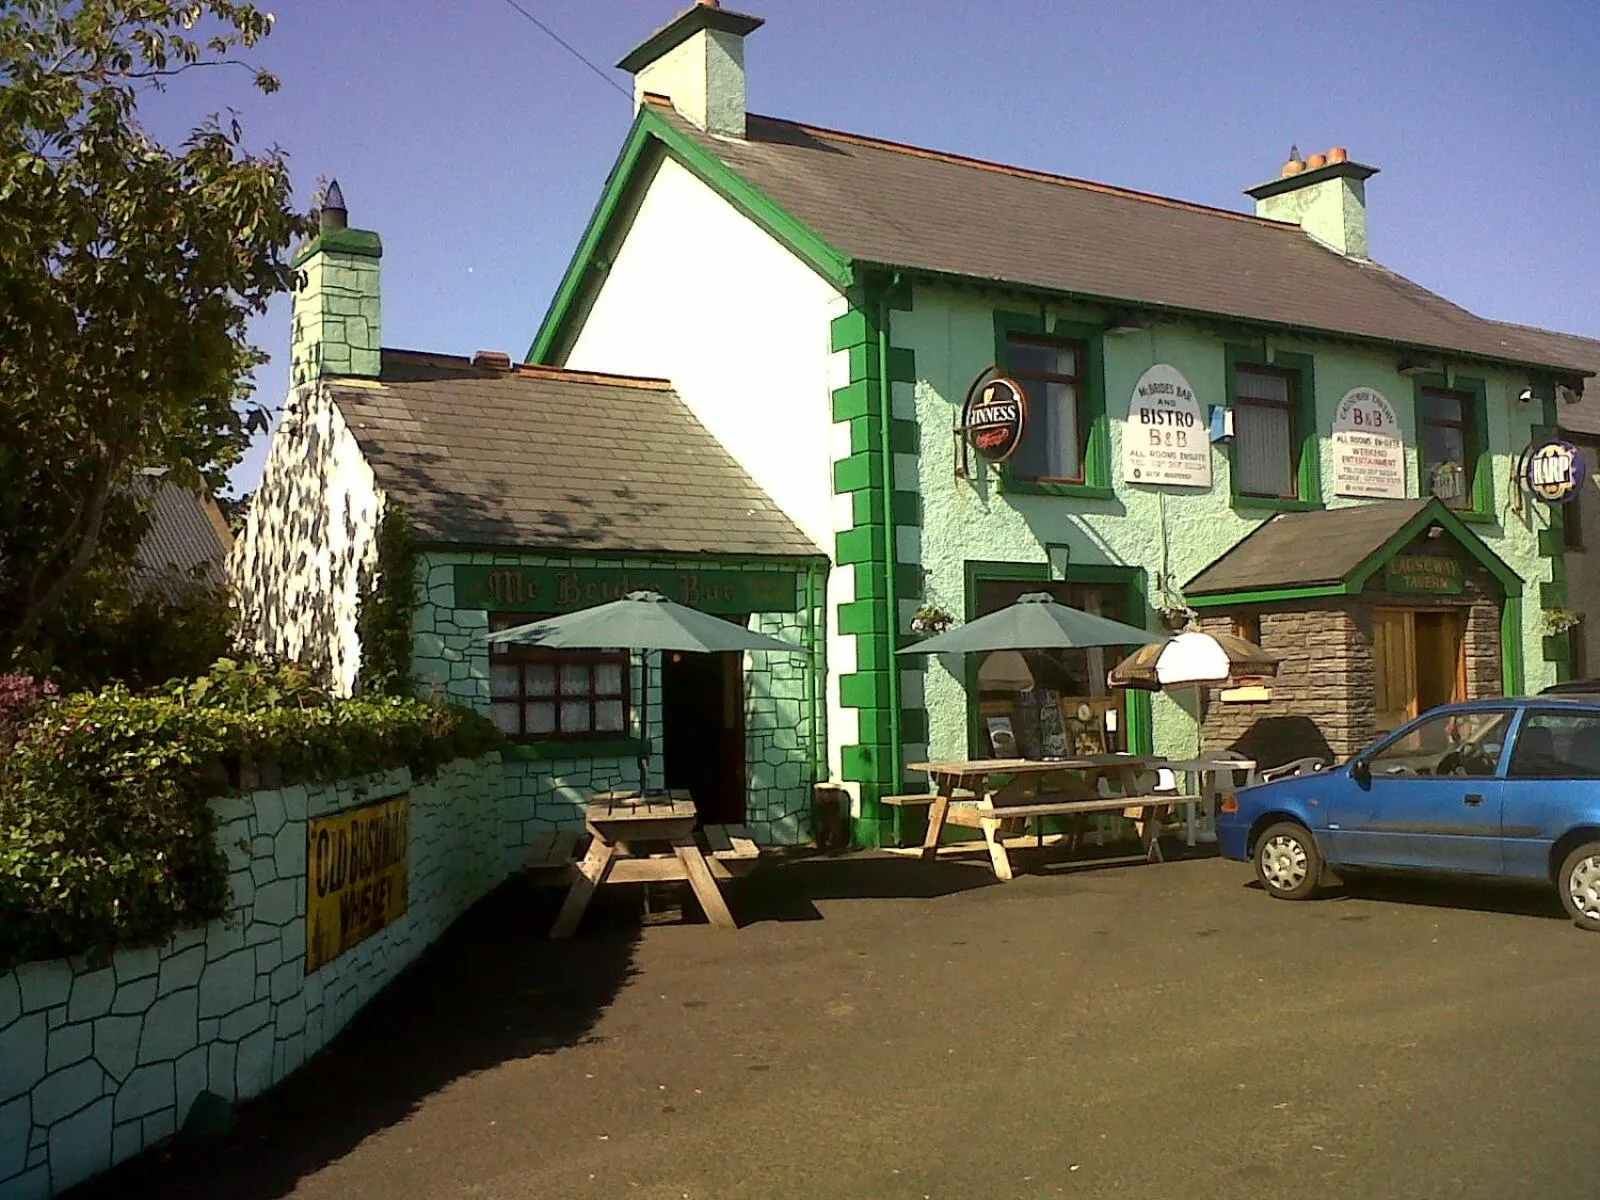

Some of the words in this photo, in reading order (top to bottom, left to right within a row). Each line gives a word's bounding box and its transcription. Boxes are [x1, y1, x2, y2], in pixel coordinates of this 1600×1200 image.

[1157, 398, 1176, 407] AND
[1176, 386, 1192, 401] BAR
[1140, 408, 1194, 428] BISTRO
[1150, 451, 1176, 460] ROOMS
[1533, 456, 1569, 485] HARP
[1391, 557, 1457, 576] CAUSEWAY
[680, 574, 734, 606] Bar
[1403, 575, 1448, 588] TAVERN
[316, 827, 346, 898] OLD
